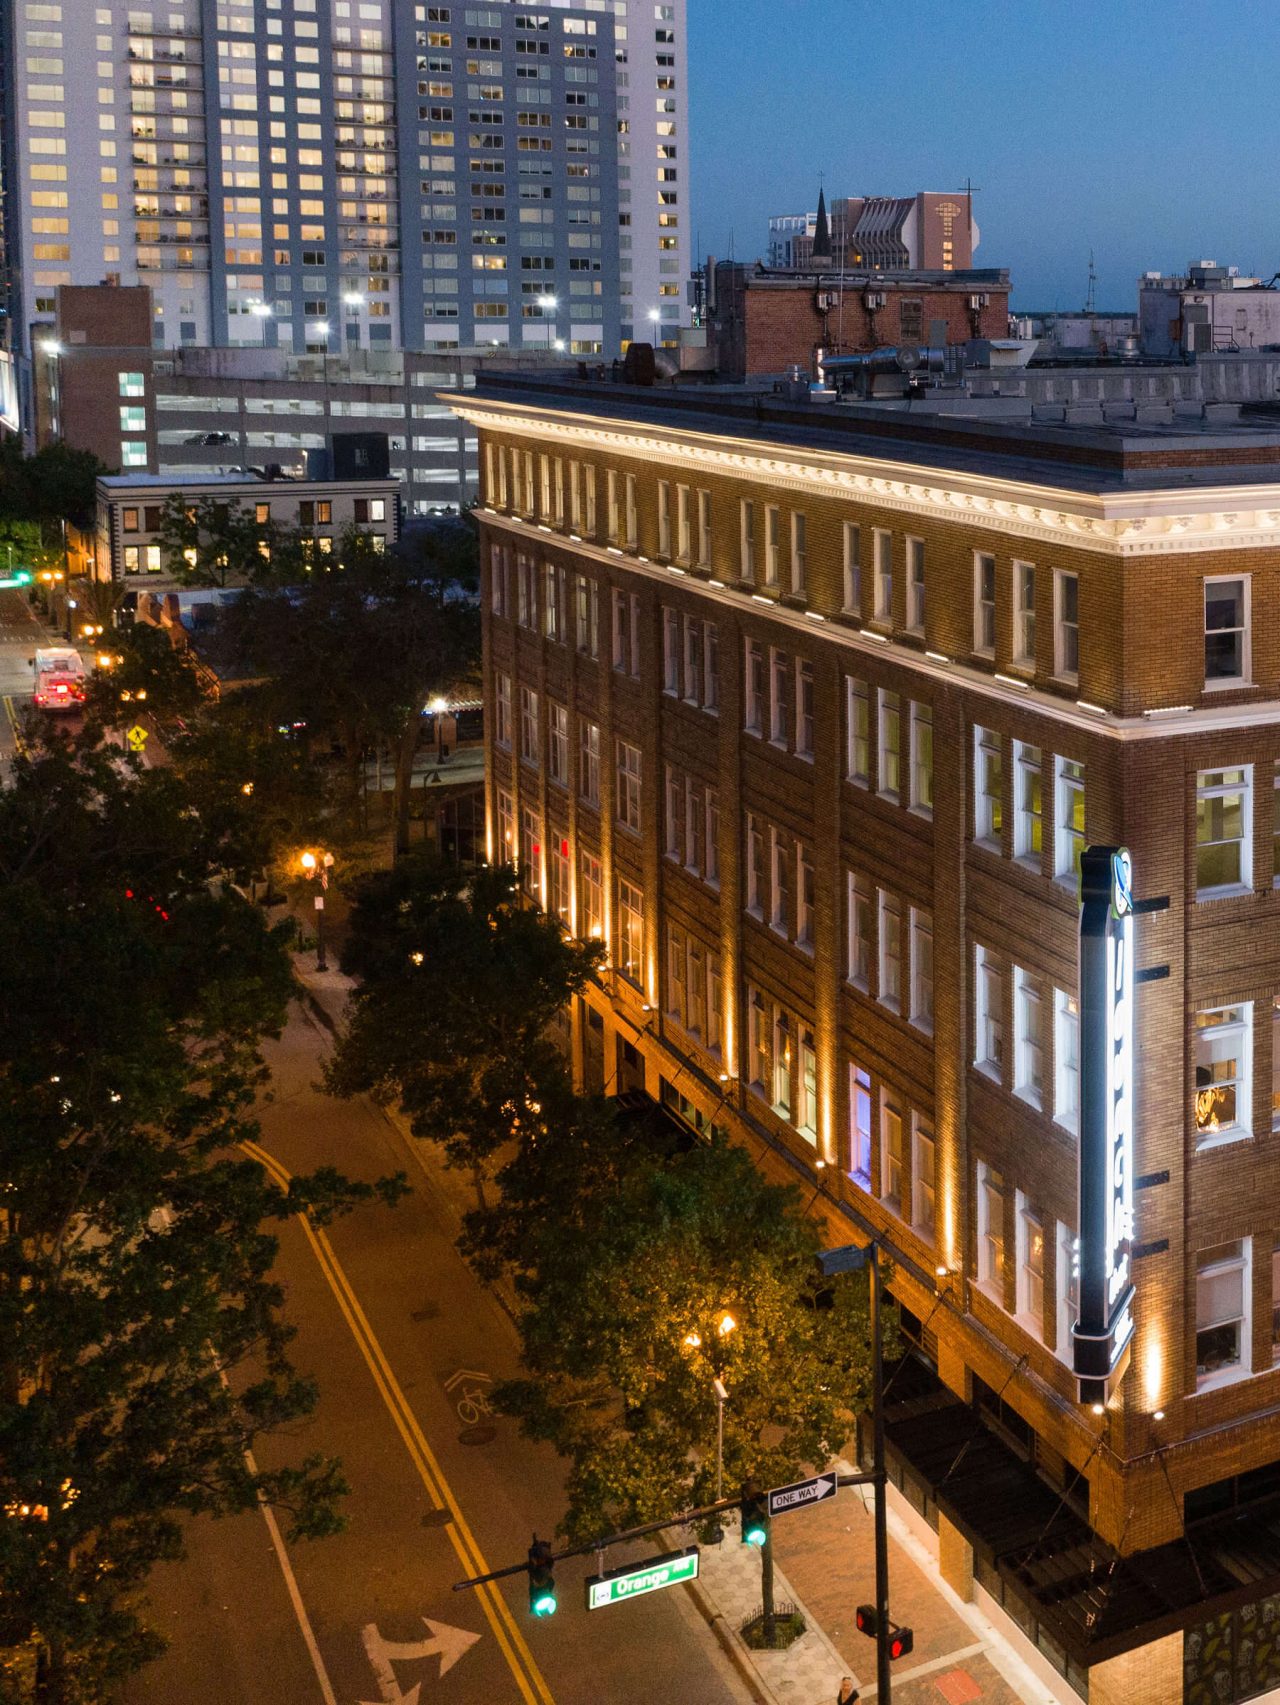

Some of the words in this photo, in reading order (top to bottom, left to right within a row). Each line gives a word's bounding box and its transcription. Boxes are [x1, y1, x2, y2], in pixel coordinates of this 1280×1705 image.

[776, 1492, 796, 1506] ONE
[798, 1485, 818, 1500] WAY
[616, 1569, 670, 1595] Orange
